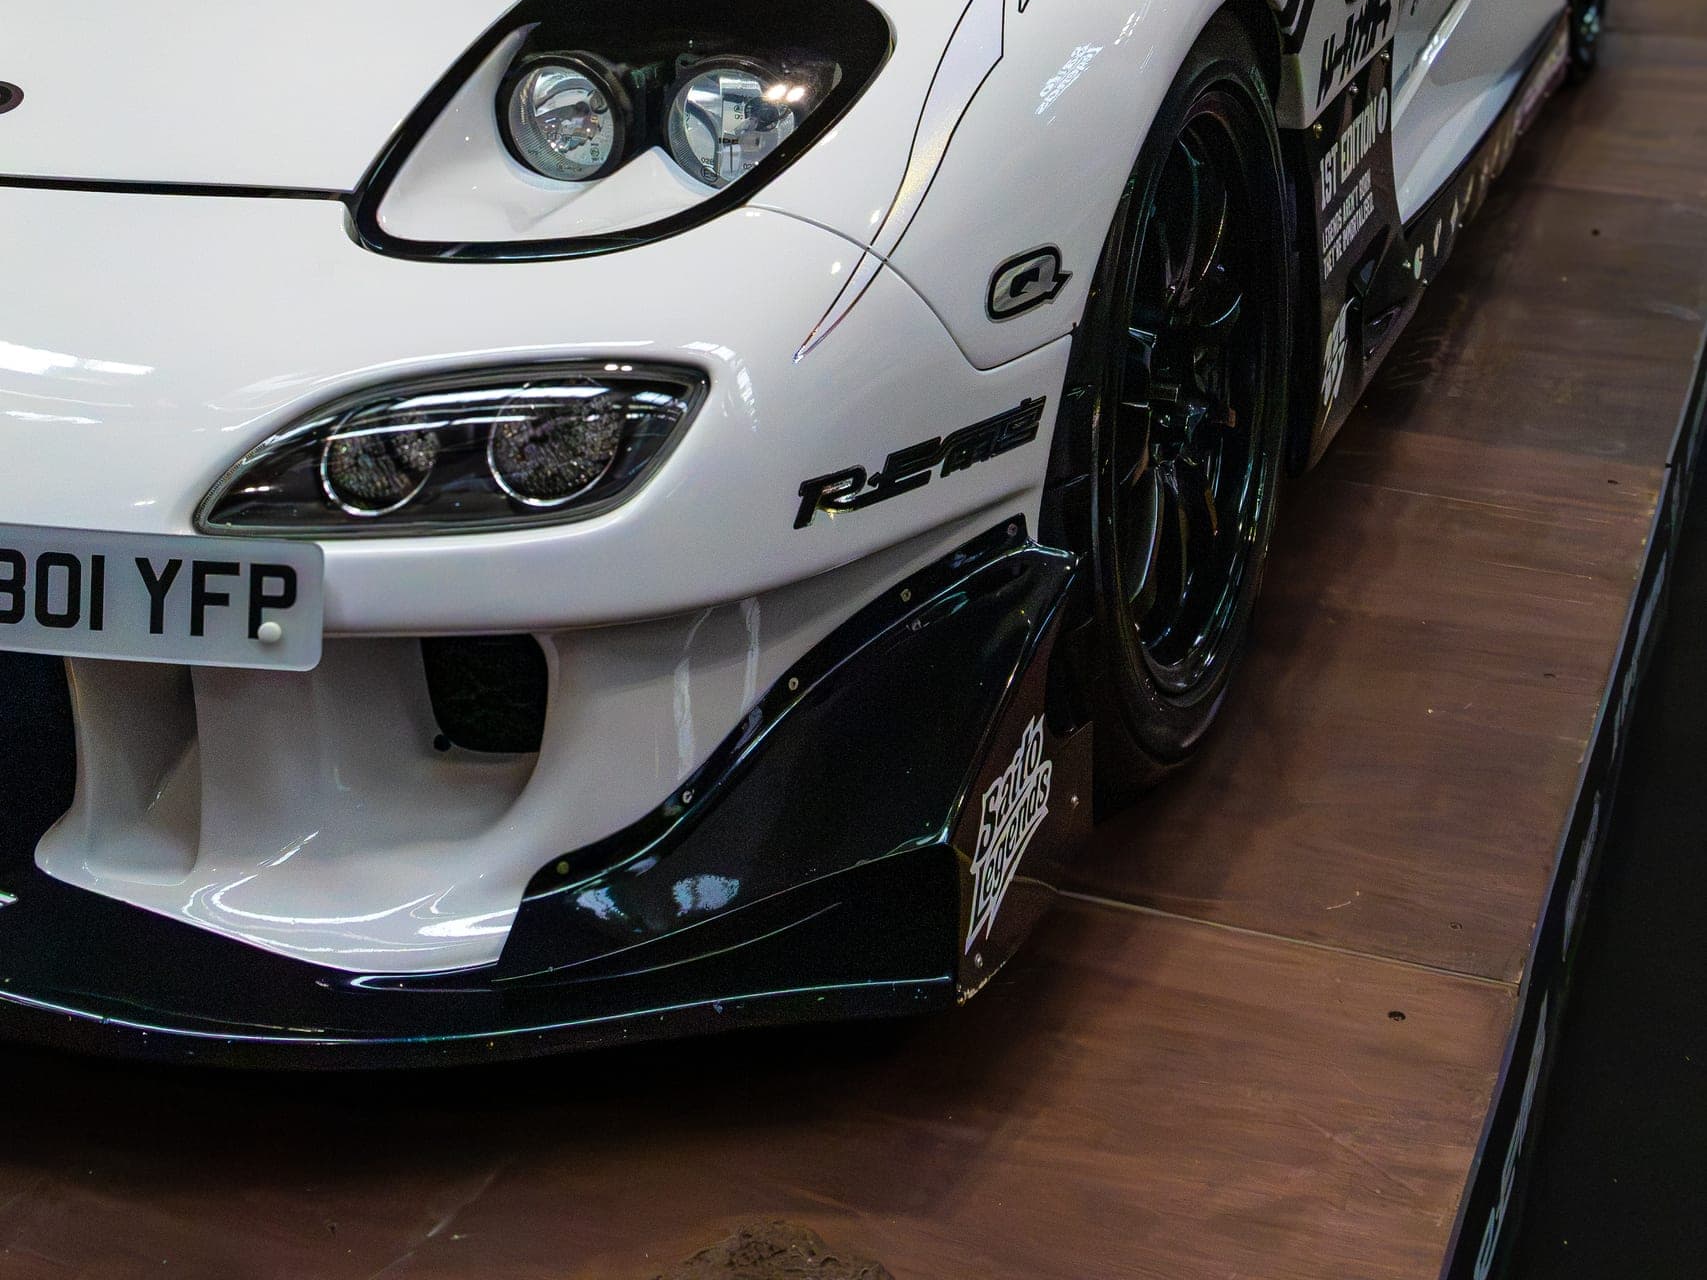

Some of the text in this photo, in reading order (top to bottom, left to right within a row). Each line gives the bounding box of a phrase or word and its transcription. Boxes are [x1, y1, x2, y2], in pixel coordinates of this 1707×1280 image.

[1320, 142, 1338, 211] 1ST
[1341, 96, 1377, 184] EDITION
[135, 557, 297, 640] YFP
[965, 759, 1053, 955] Legends
[970, 712, 1046, 874] Saito
